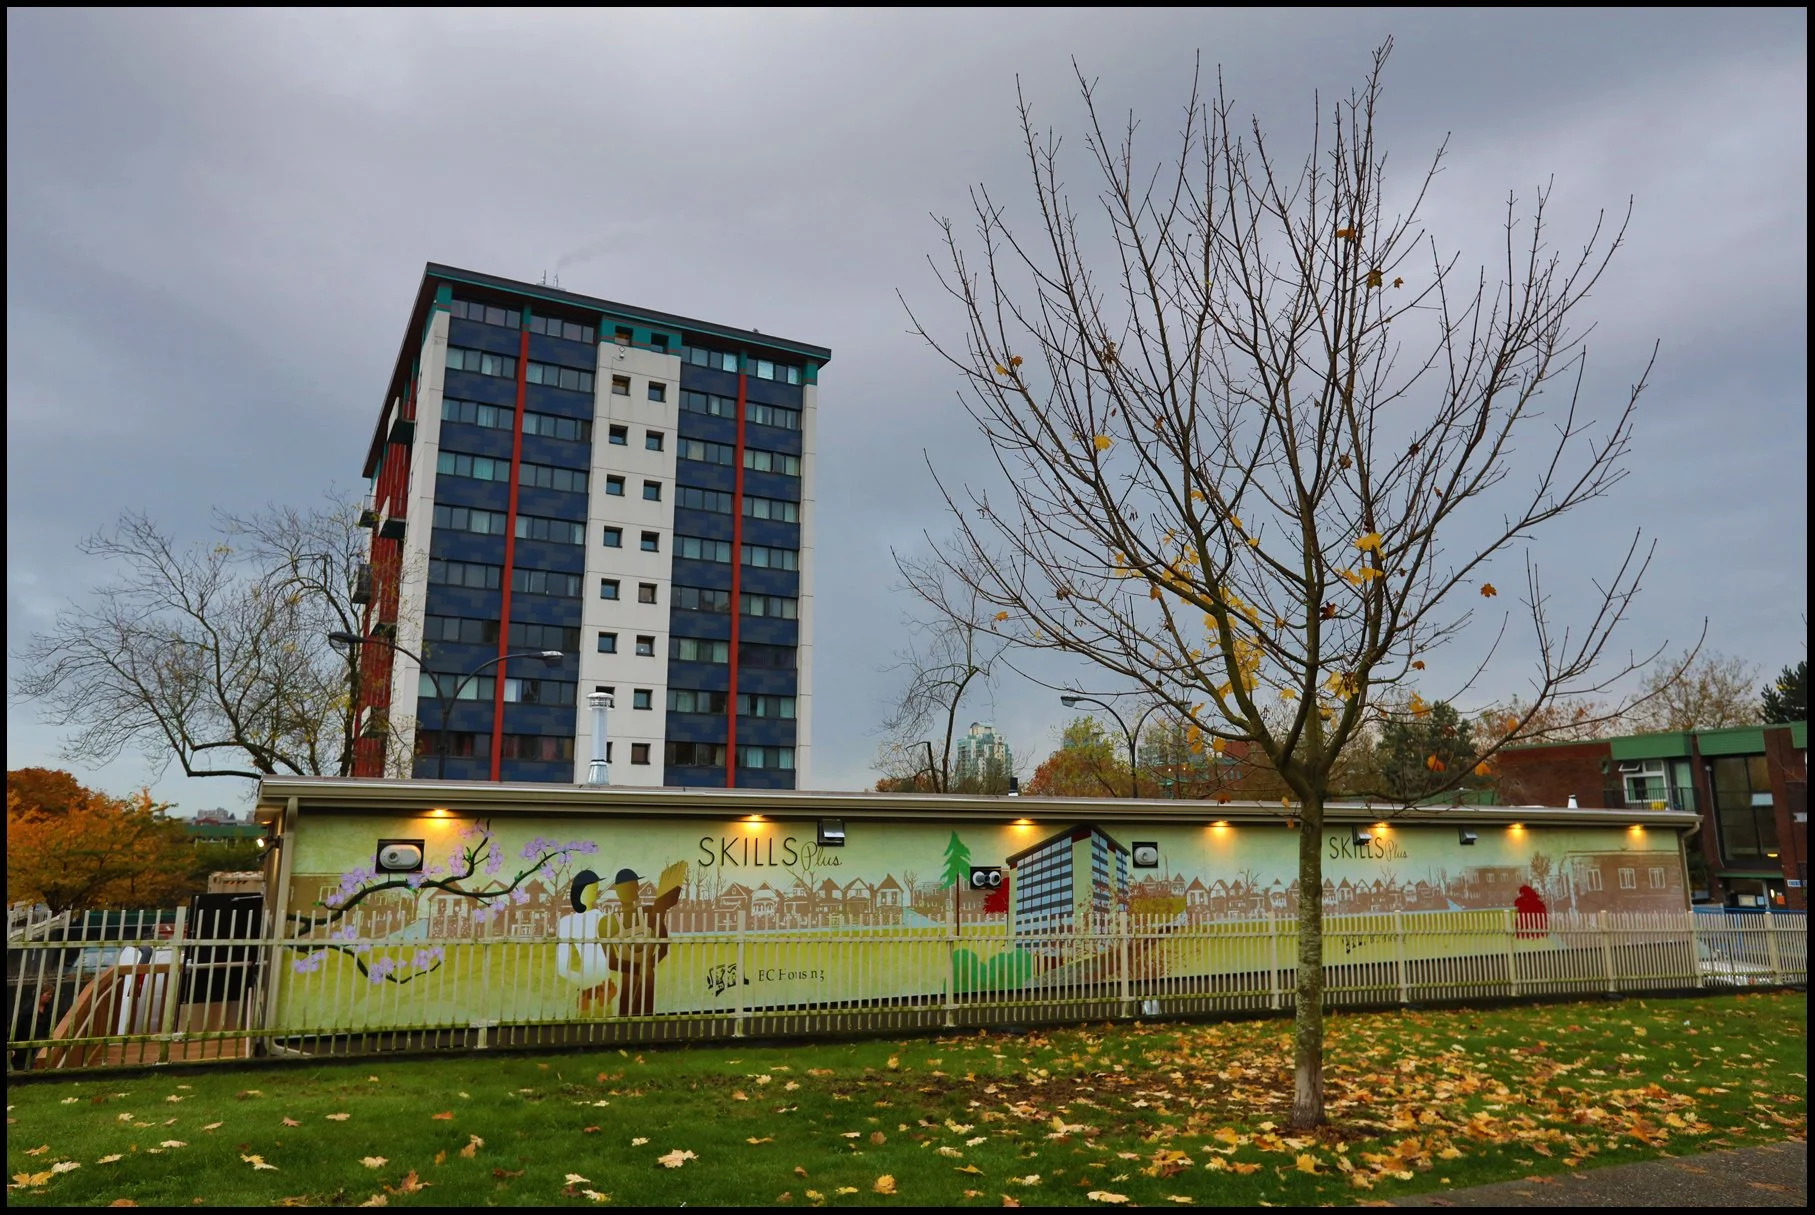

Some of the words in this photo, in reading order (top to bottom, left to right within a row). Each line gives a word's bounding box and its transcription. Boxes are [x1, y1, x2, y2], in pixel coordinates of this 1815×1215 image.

[698, 836, 798, 867] SKILLS
[801, 841, 842, 871] Plus
[1385, 839, 1408, 862] Plus
